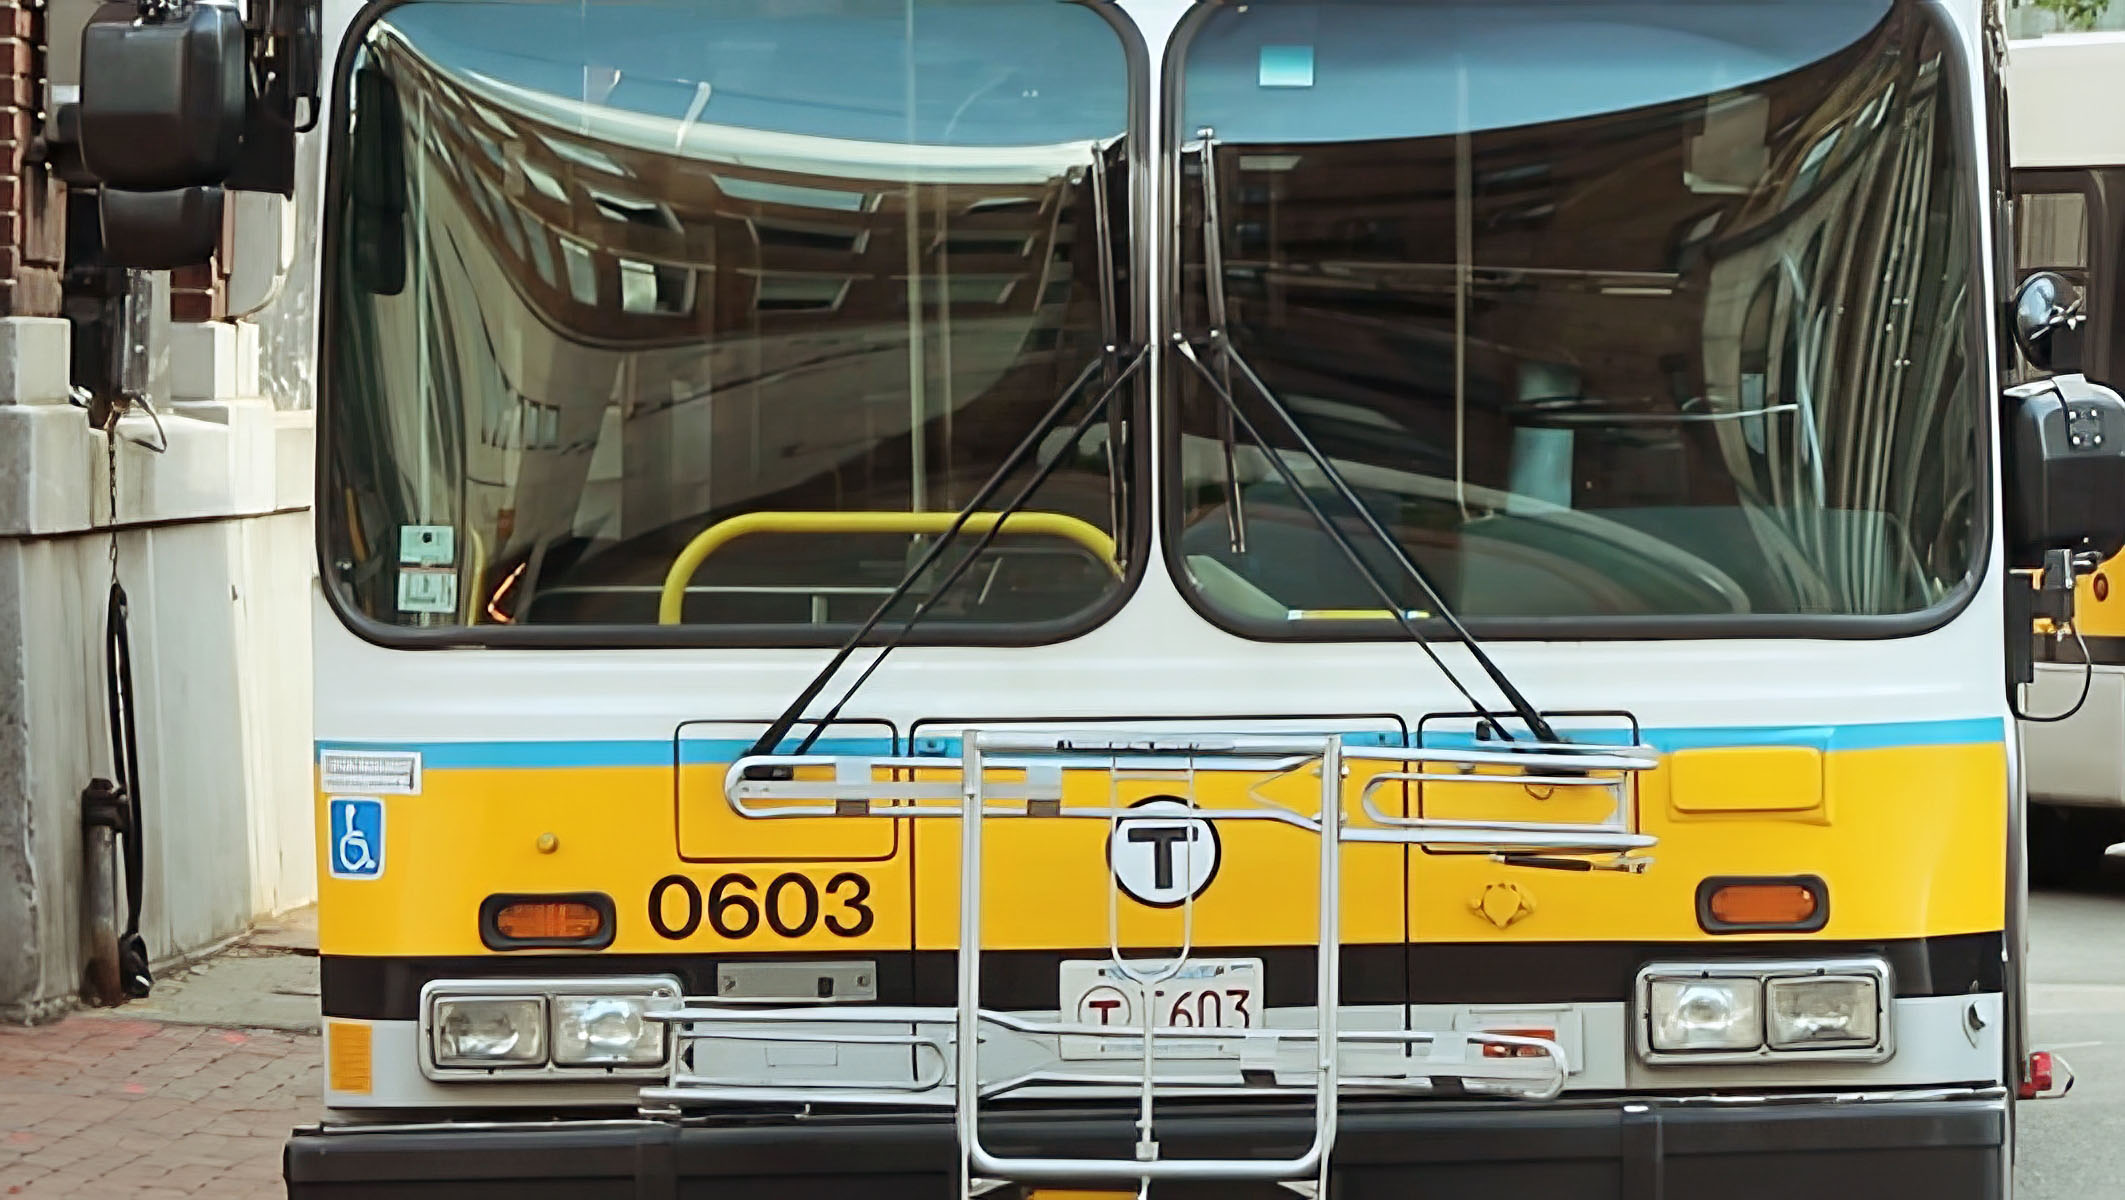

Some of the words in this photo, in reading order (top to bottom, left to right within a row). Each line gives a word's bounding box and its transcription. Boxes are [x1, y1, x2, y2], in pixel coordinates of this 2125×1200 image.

[1127, 826, 1199, 890] T
[648, 872, 874, 940] 0603
[1141, 989, 1250, 1029] 603
